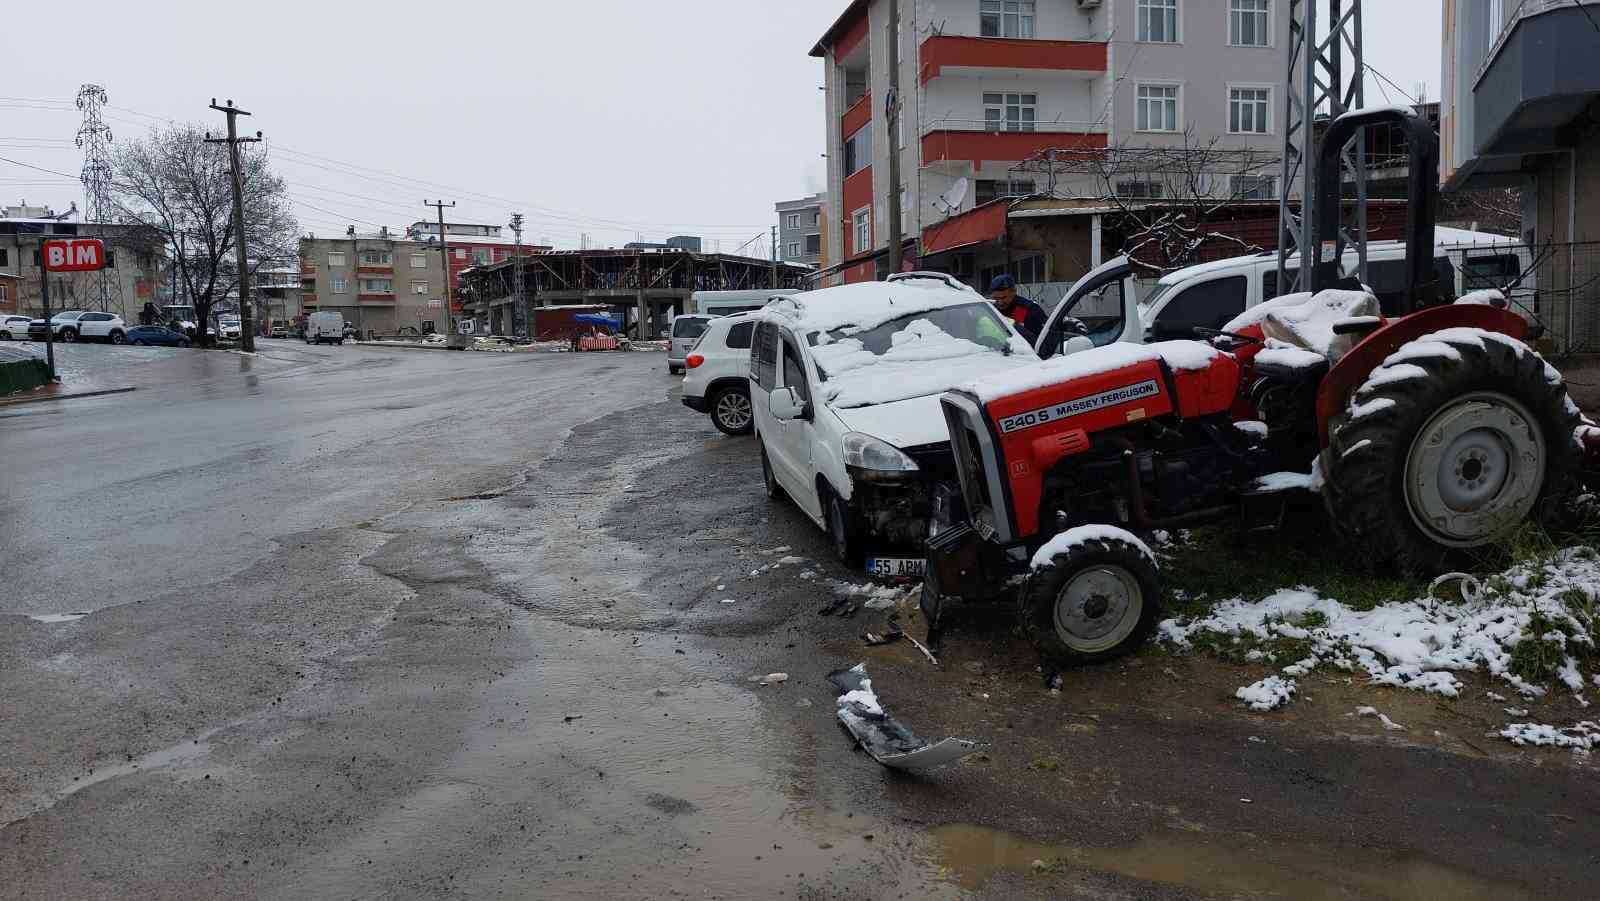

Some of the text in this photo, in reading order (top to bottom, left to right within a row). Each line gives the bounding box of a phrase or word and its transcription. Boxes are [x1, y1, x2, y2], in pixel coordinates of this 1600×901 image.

[1004, 384, 1154, 431] 240 S MASSEY FERGUSON
[875, 560, 891, 575] 55
